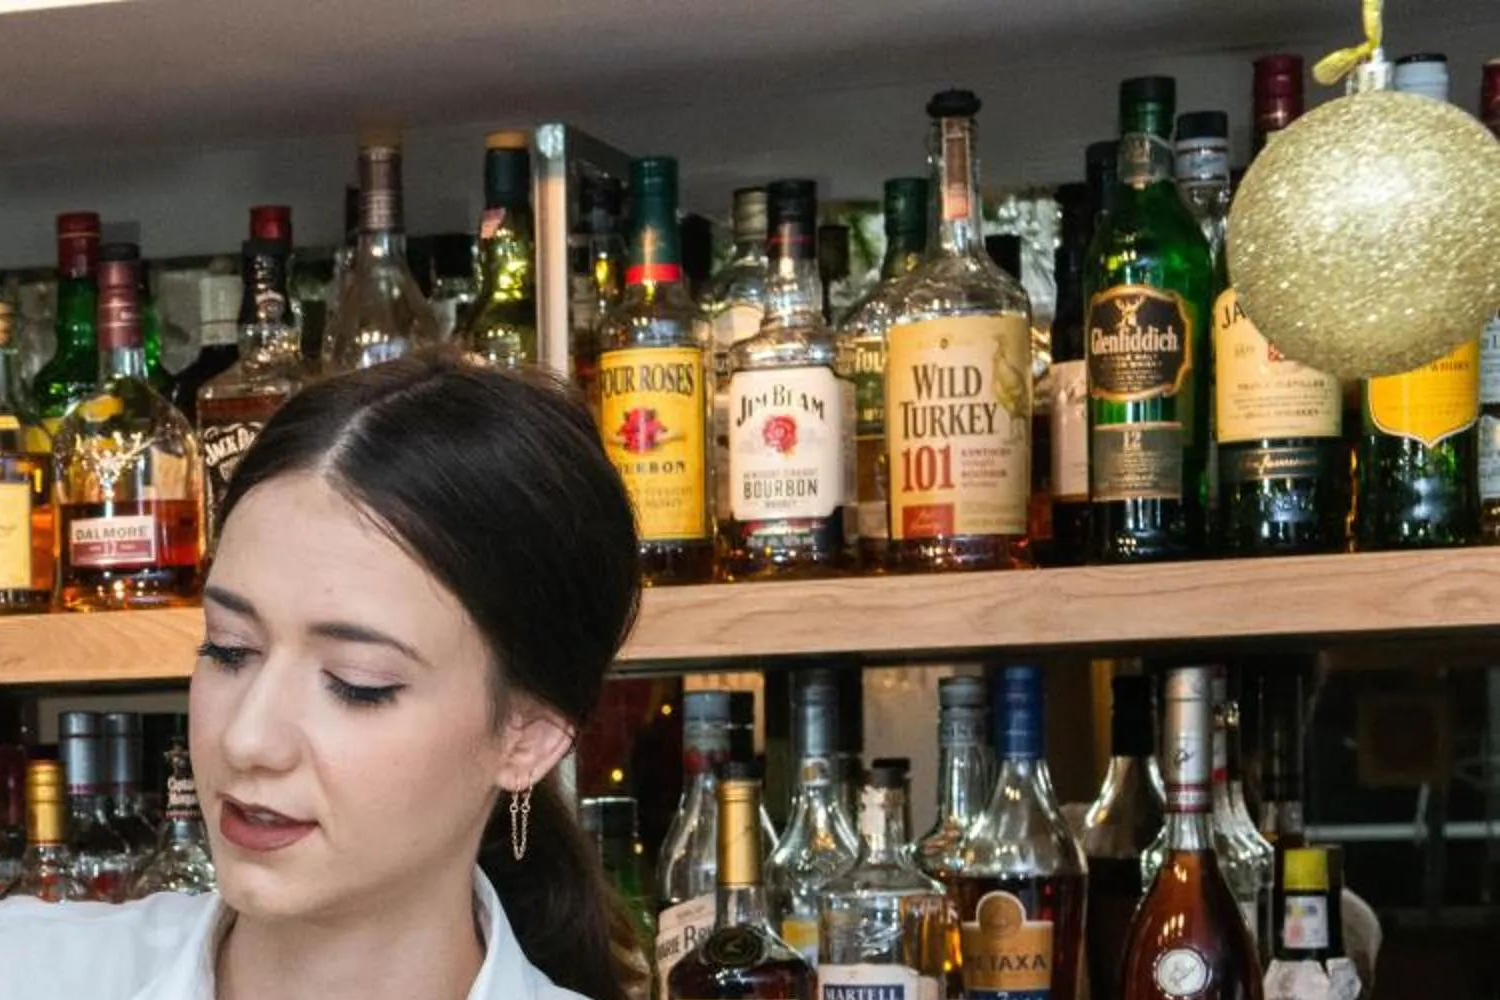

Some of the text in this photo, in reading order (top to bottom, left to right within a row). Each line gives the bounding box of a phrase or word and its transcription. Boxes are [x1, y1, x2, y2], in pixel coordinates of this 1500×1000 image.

[1091, 325, 1179, 355] Glenfiddich
[601, 362, 695, 399] OUR ROSES
[911, 363, 983, 401] WILD
[735, 383, 825, 427] JIM BEAM
[899, 400, 998, 440] TURKEY
[901, 445, 955, 493] 101
[743, 478, 819, 500] BOURBON
[75, 525, 150, 541] DALMORE
